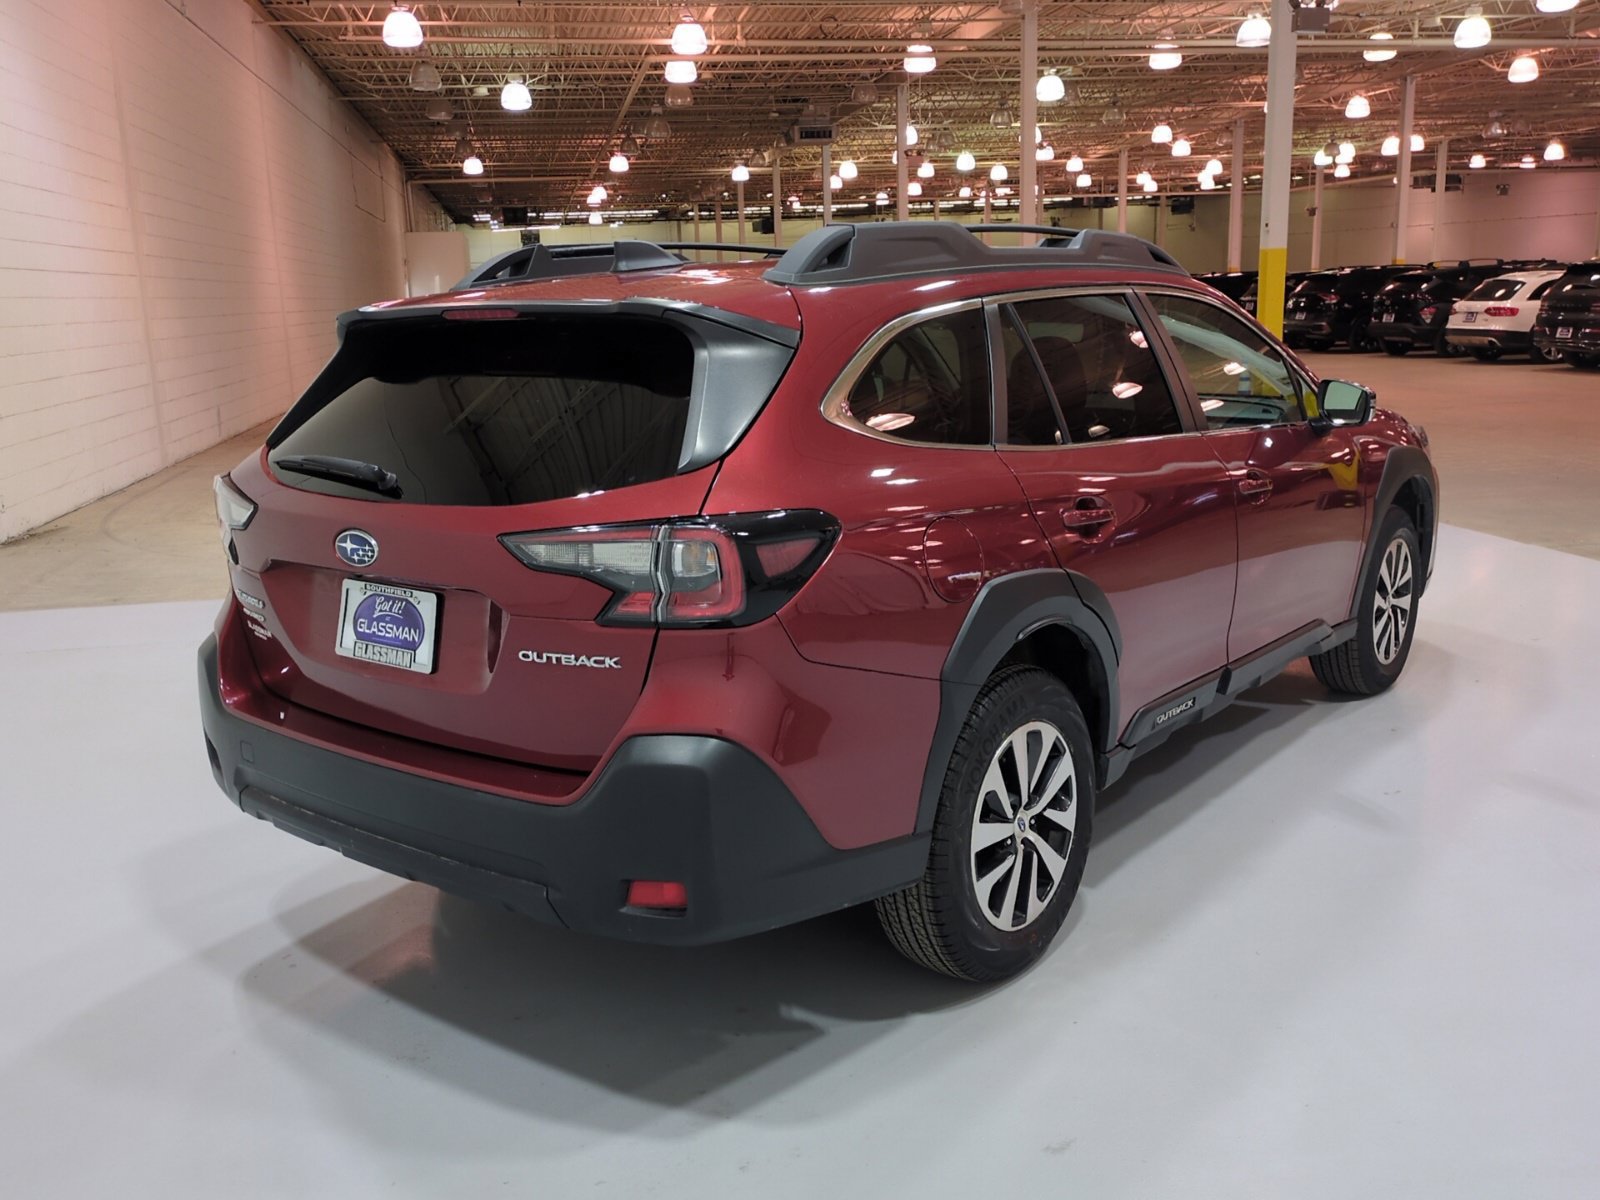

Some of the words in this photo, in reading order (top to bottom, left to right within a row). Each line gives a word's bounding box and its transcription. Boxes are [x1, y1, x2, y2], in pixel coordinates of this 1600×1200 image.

[365, 584, 412, 597] SOUTHFIELD
[374, 596, 392, 614] Got
[392, 600, 405, 614] it!
[357, 618, 419, 642] GLASSMAN
[355, 641, 412, 668] GLASSMAN
[518, 650, 622, 668] OUTBACK
[1156, 699, 1194, 724] OUTBACK
[965, 694, 1028, 796] YOKOHAMA
